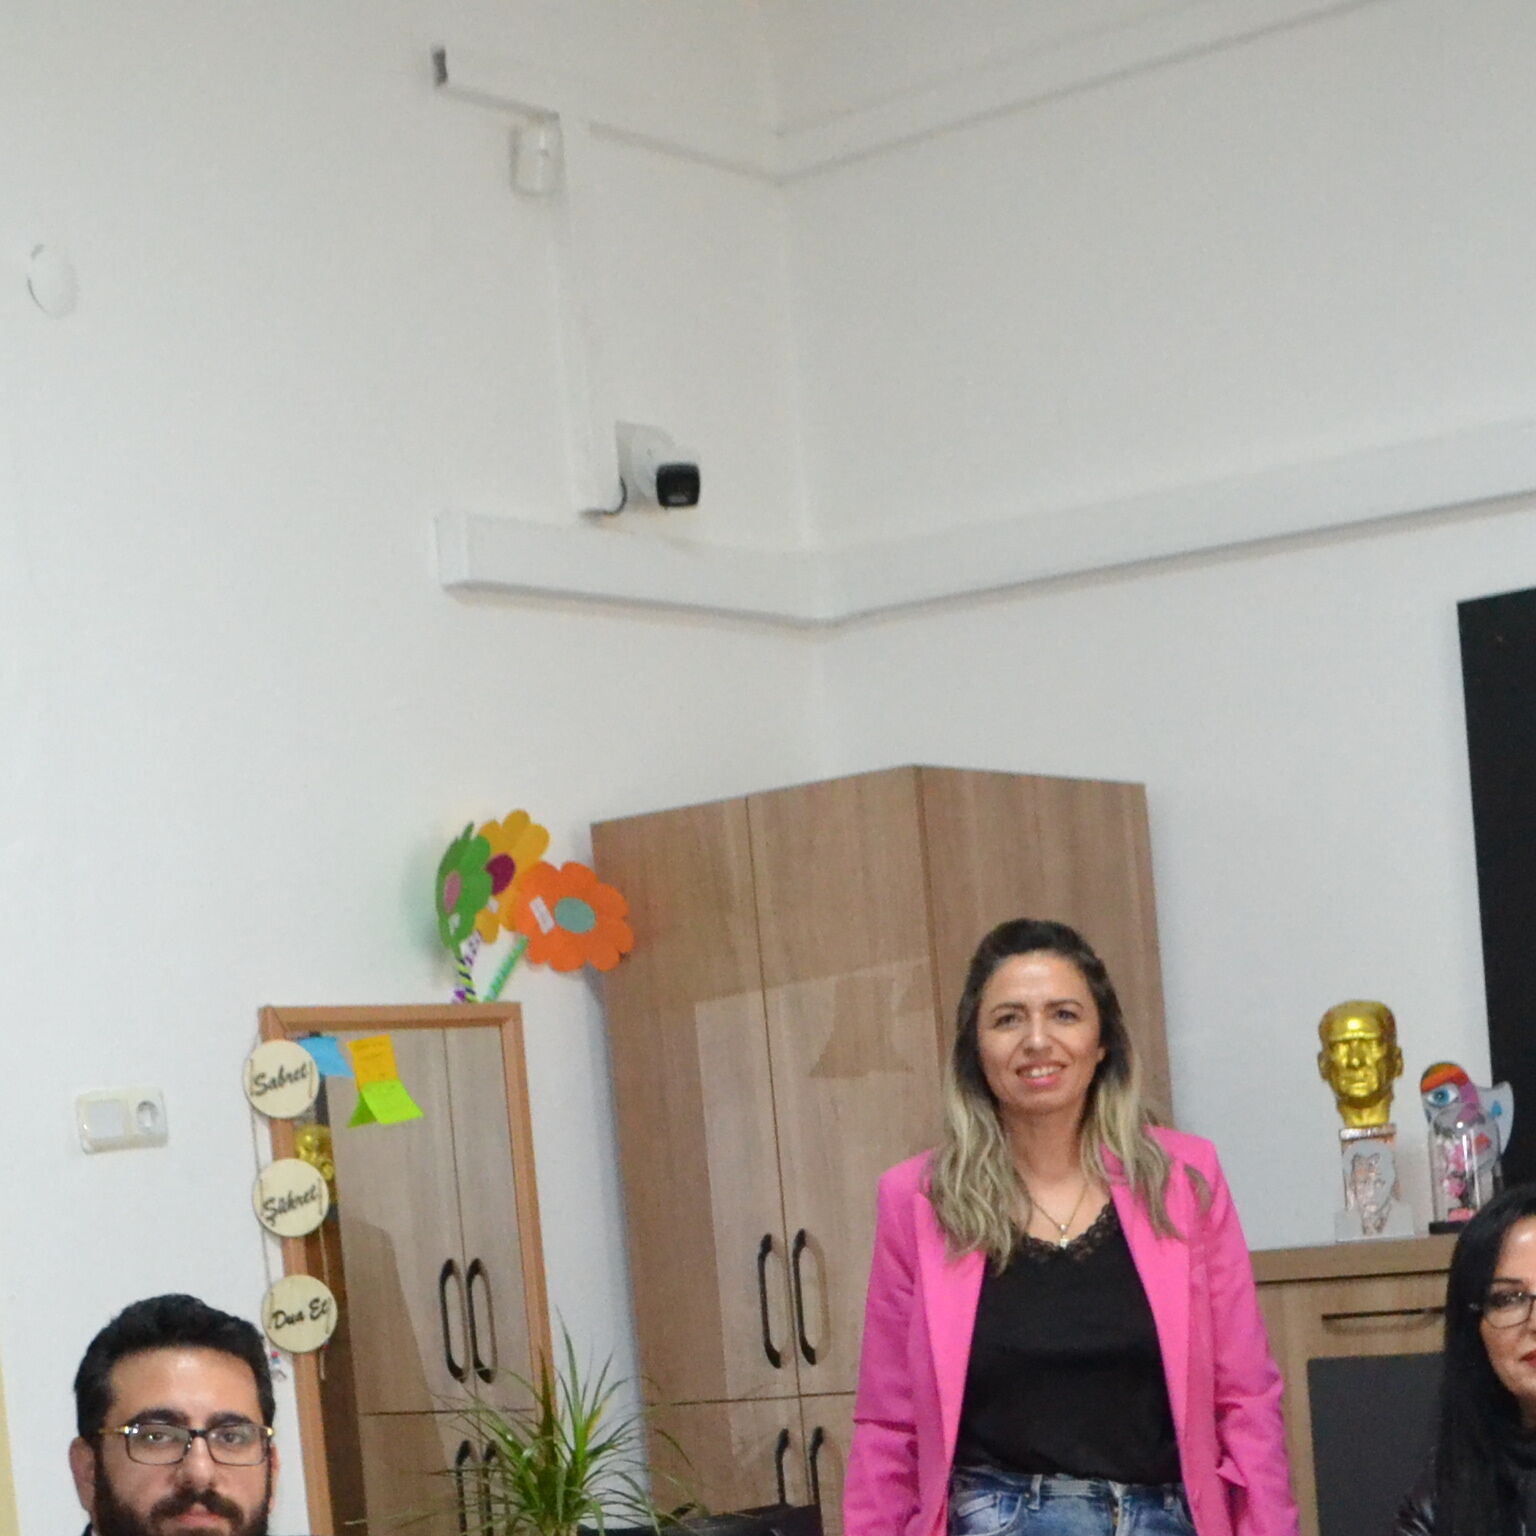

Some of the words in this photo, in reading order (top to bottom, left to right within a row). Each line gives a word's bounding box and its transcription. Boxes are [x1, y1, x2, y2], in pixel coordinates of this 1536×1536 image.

[251, 1062, 308, 1097] Sabret
[262, 1184, 319, 1227] Şükret
[272, 1309, 305, 1330] Dua
[309, 1297, 330, 1320] Et
